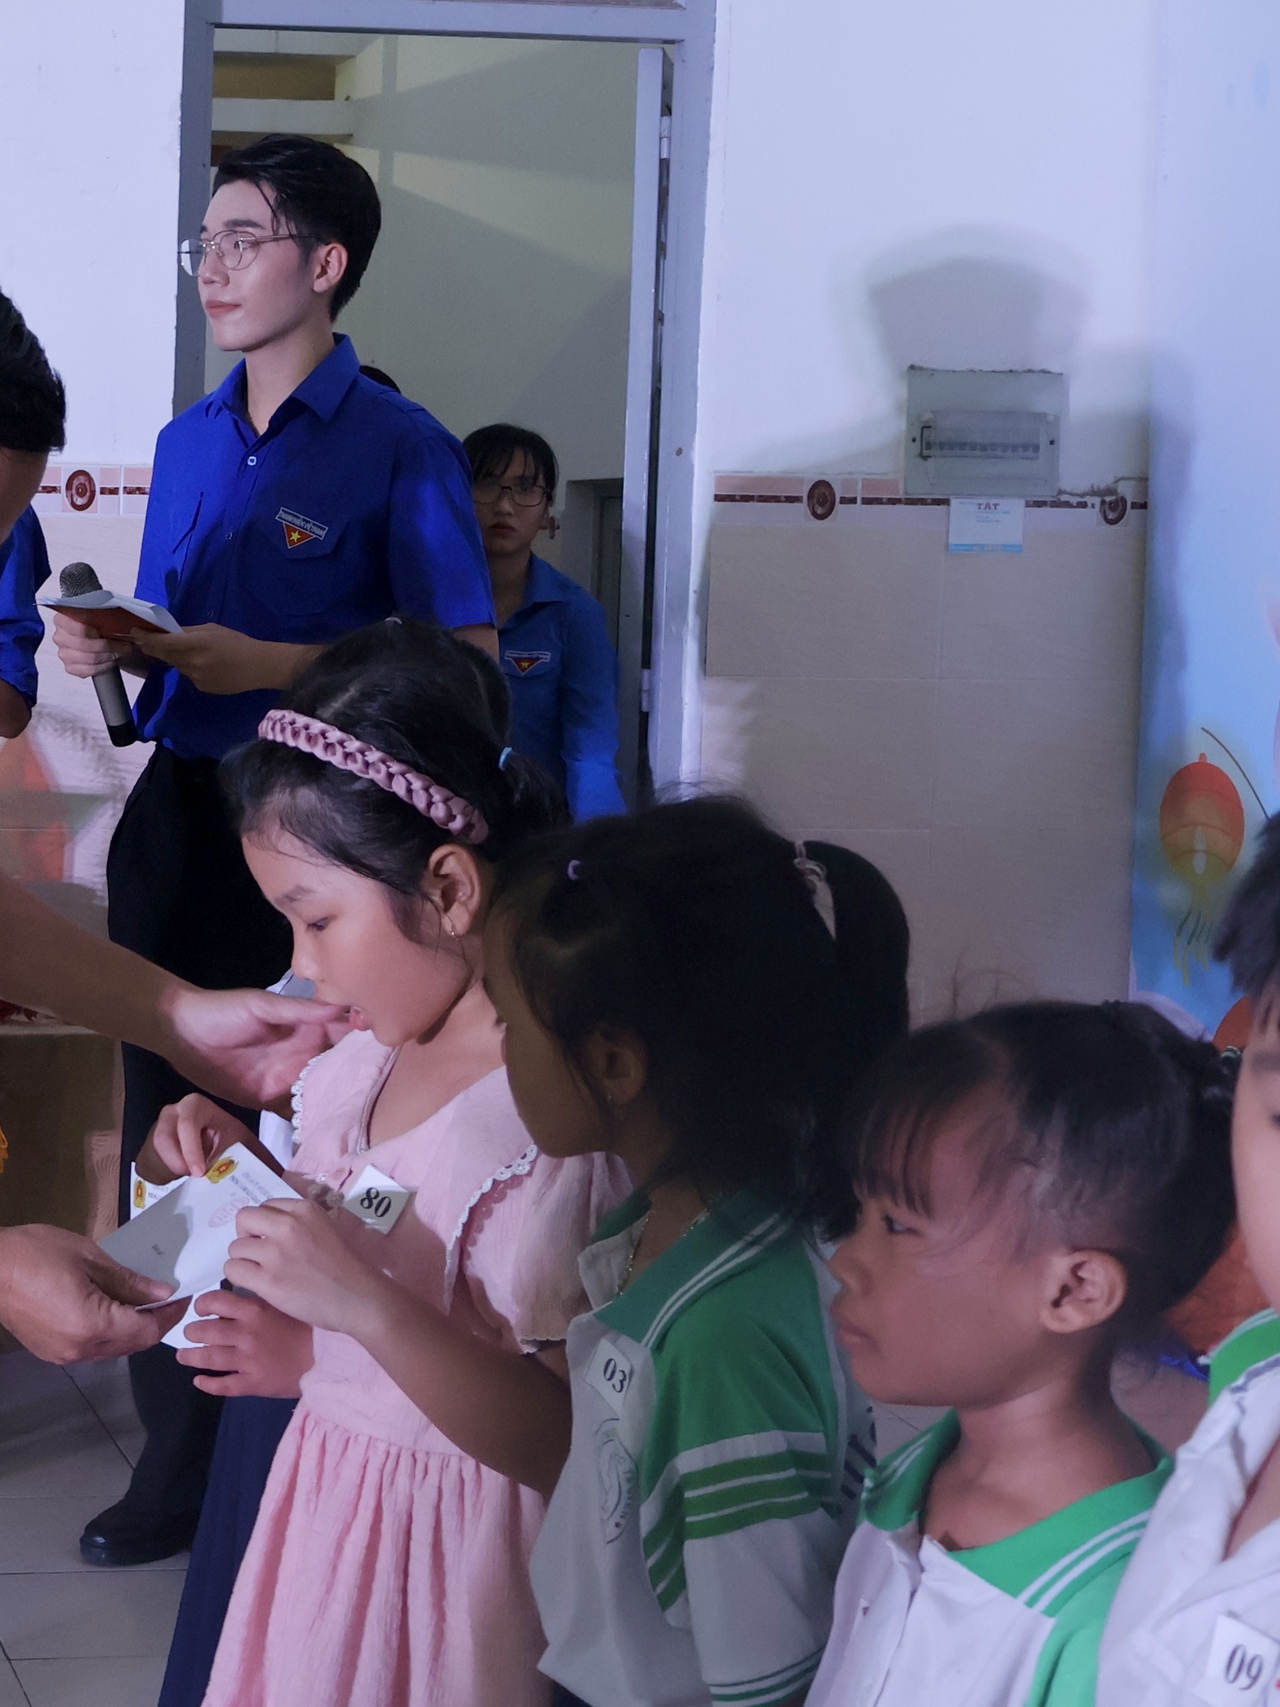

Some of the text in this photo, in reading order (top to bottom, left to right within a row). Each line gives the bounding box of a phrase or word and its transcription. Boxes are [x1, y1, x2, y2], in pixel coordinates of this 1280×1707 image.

[360, 1187, 392, 1217] 80
[603, 1358, 627, 1393] 03
[1225, 1644, 1264, 1691] 09
